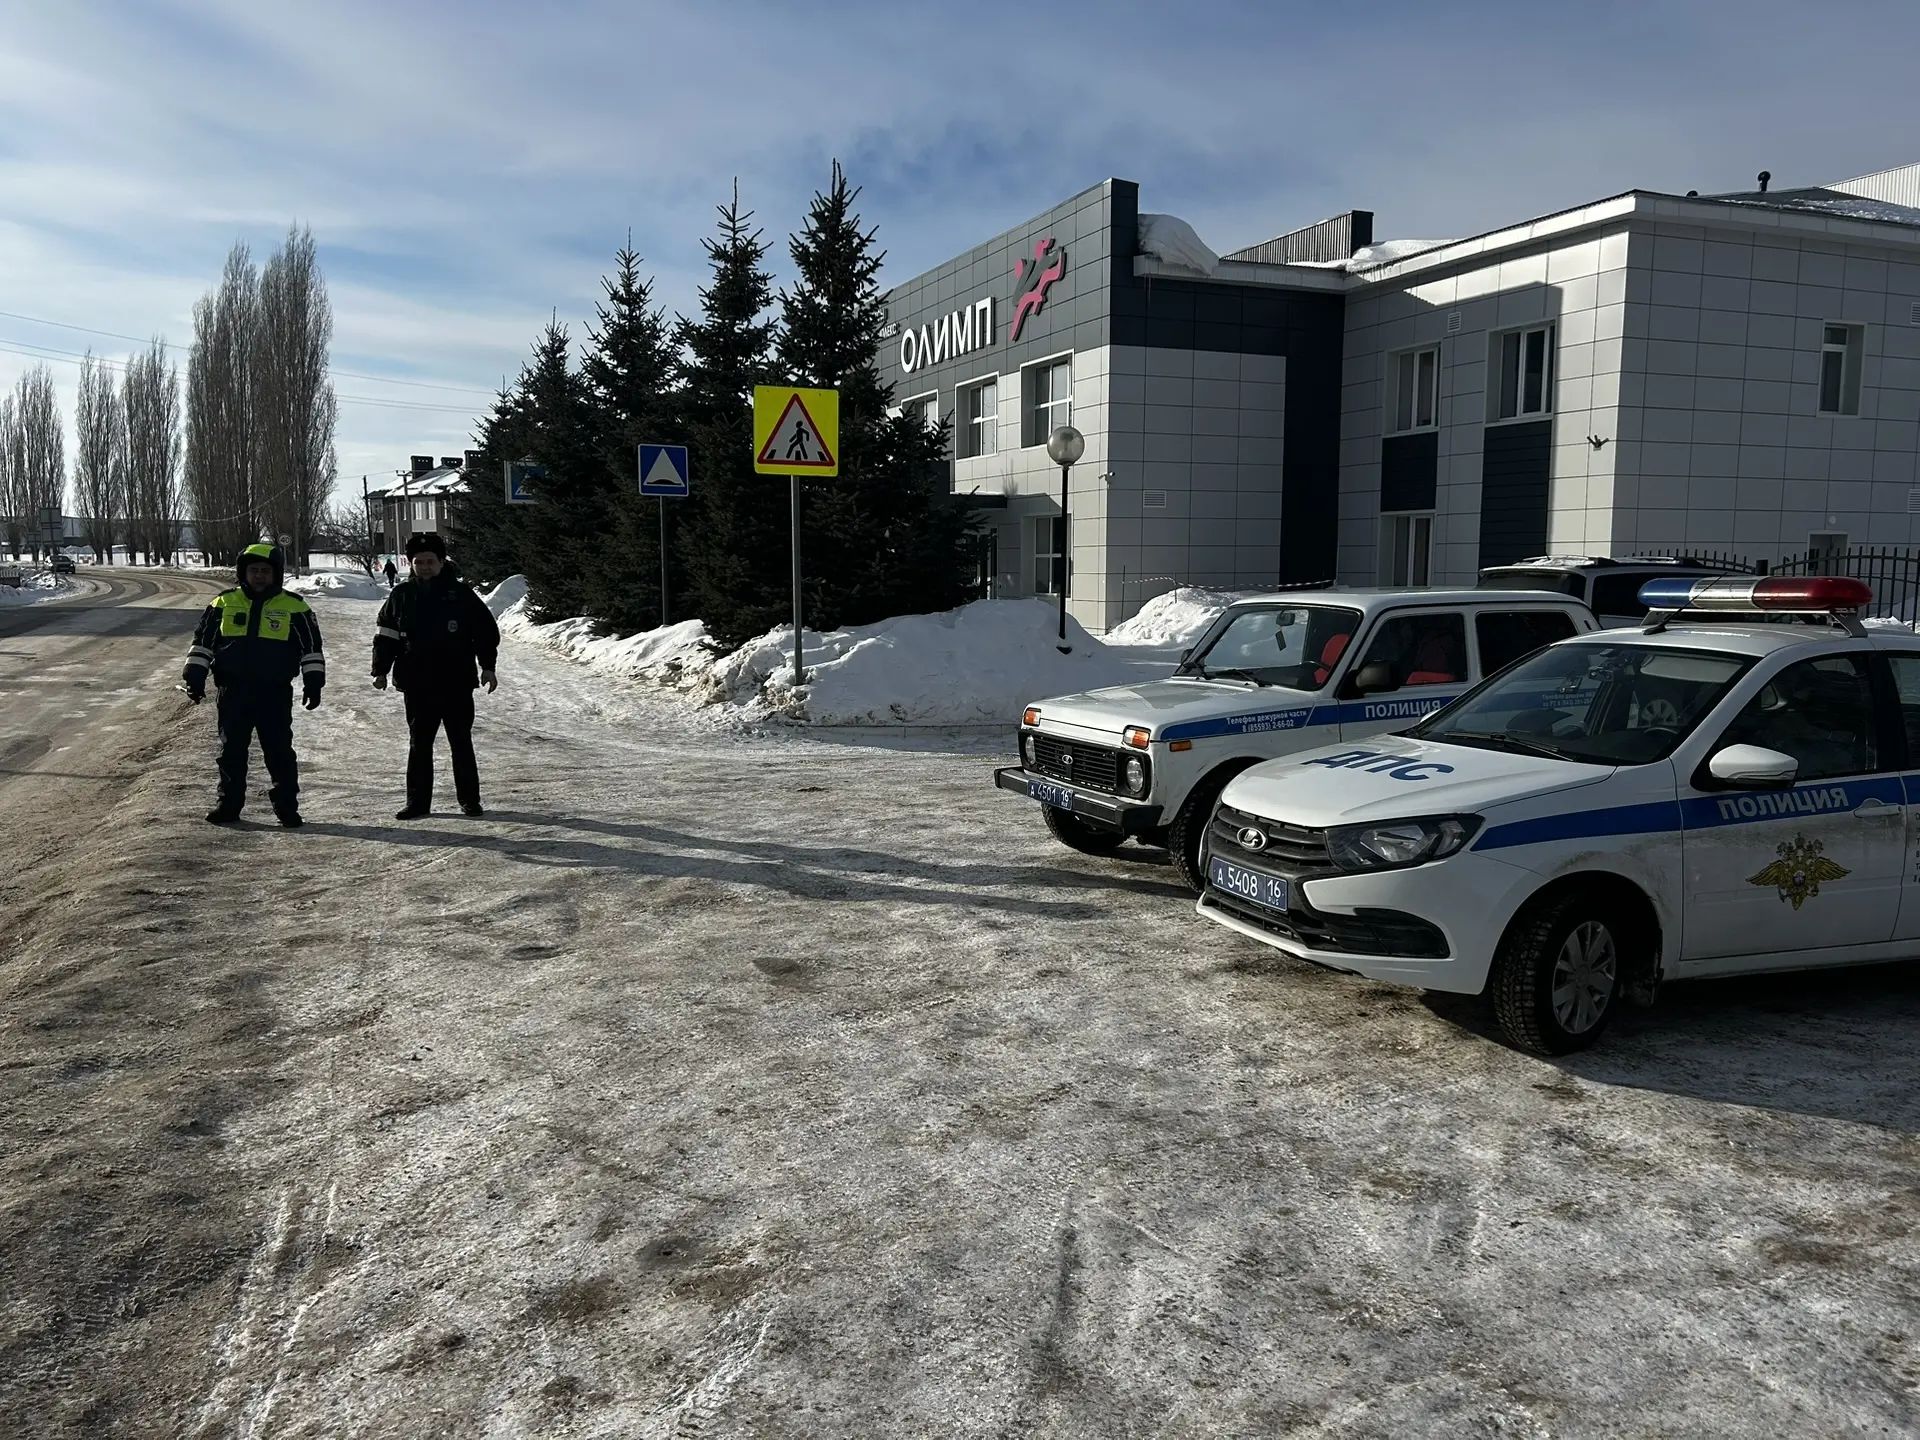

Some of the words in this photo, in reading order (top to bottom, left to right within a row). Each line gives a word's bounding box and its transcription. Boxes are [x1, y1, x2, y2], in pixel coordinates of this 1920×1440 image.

[900, 296, 994, 374] ОЛИМП
[1226, 716, 1256, 725] Телефон
[1257, 712, 1288, 723] дежурной
[1364, 700, 1441, 719] ПОЛИЦИЯ
[1300, 750, 1455, 781] ДПС
[1030, 785, 1035, 797] А
[1037, 783, 1056, 803] 4501
[1060, 789, 1069, 802] 16
[1716, 787, 1849, 820] ПОЛИЦИЯ
[1217, 868, 1224, 885] А
[1227, 866, 1258, 897] 5408
[1267, 879, 1281, 898] 16
[1268, 896, 1280, 906] RUS
